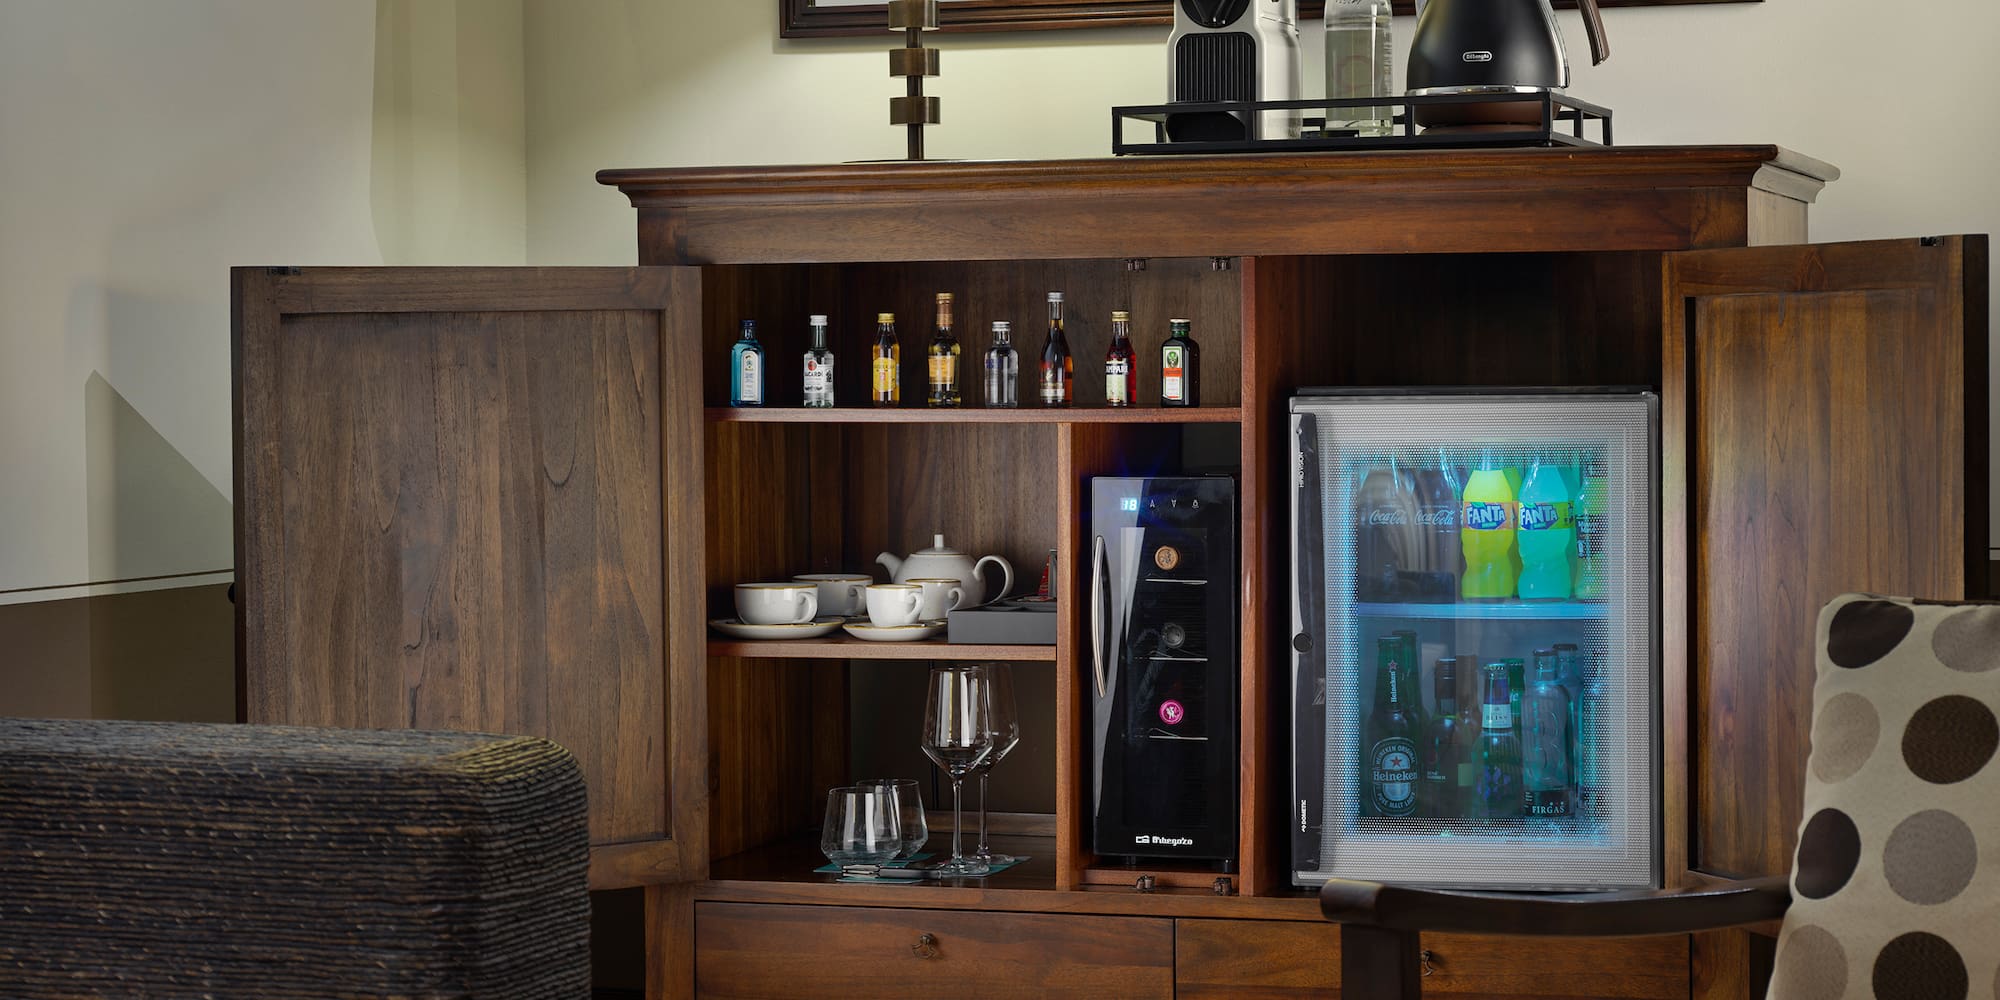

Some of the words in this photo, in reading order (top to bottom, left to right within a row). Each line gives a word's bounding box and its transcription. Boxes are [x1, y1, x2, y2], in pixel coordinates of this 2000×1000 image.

[1124, 499, 1138, 511] 18
[1466, 504, 1505, 525] FANTA
[1520, 505, 1558, 526] FANTA
[1389, 671, 1398, 703] Heineken
[1373, 769, 1418, 781] Heineken
[1531, 805, 1565, 814] FIRGAS
